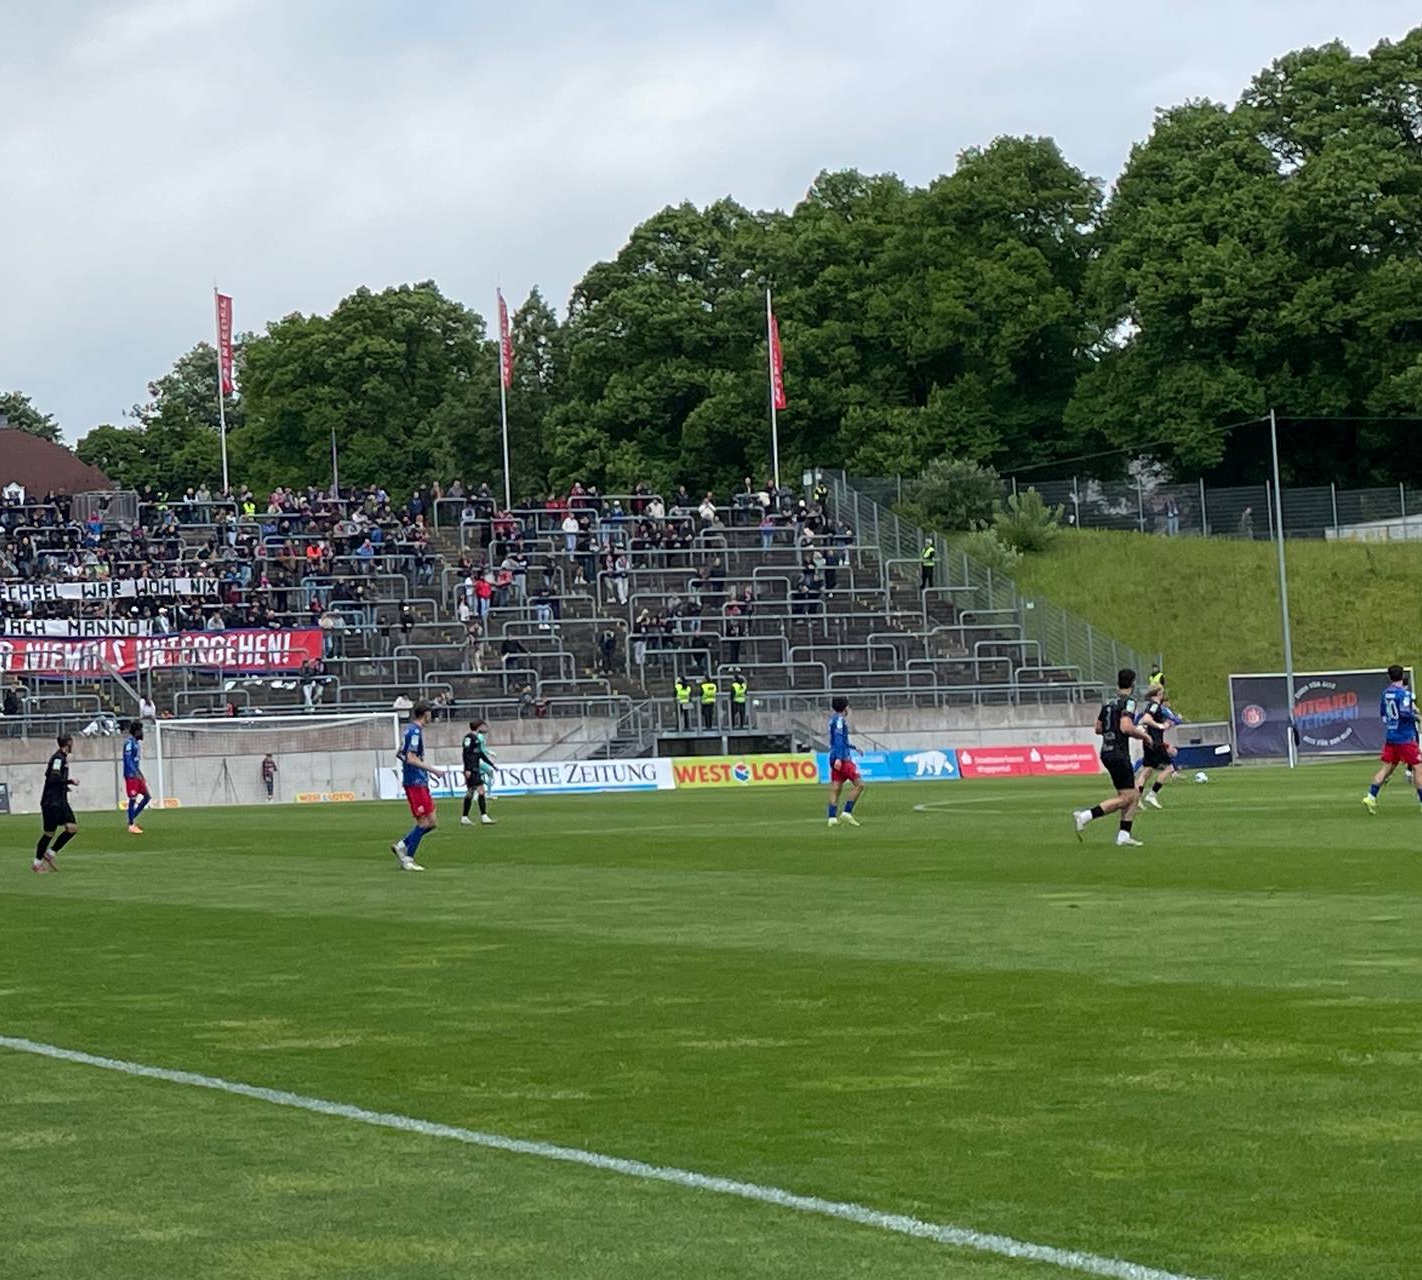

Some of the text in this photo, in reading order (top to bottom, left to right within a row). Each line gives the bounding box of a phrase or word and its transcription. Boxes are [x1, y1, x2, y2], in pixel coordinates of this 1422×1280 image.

[82, 581, 122, 597] WAR
[135, 579, 181, 596] WOHL
[191, 579, 217, 594] NIX
[11, 619, 46, 635] ACH
[25, 639, 126, 671] NIEMALS
[136, 632, 292, 670] UNTERGEHEN!
[566, 763, 657, 784] ZEITUNG
[674, 760, 817, 784] WEST LOTTO
